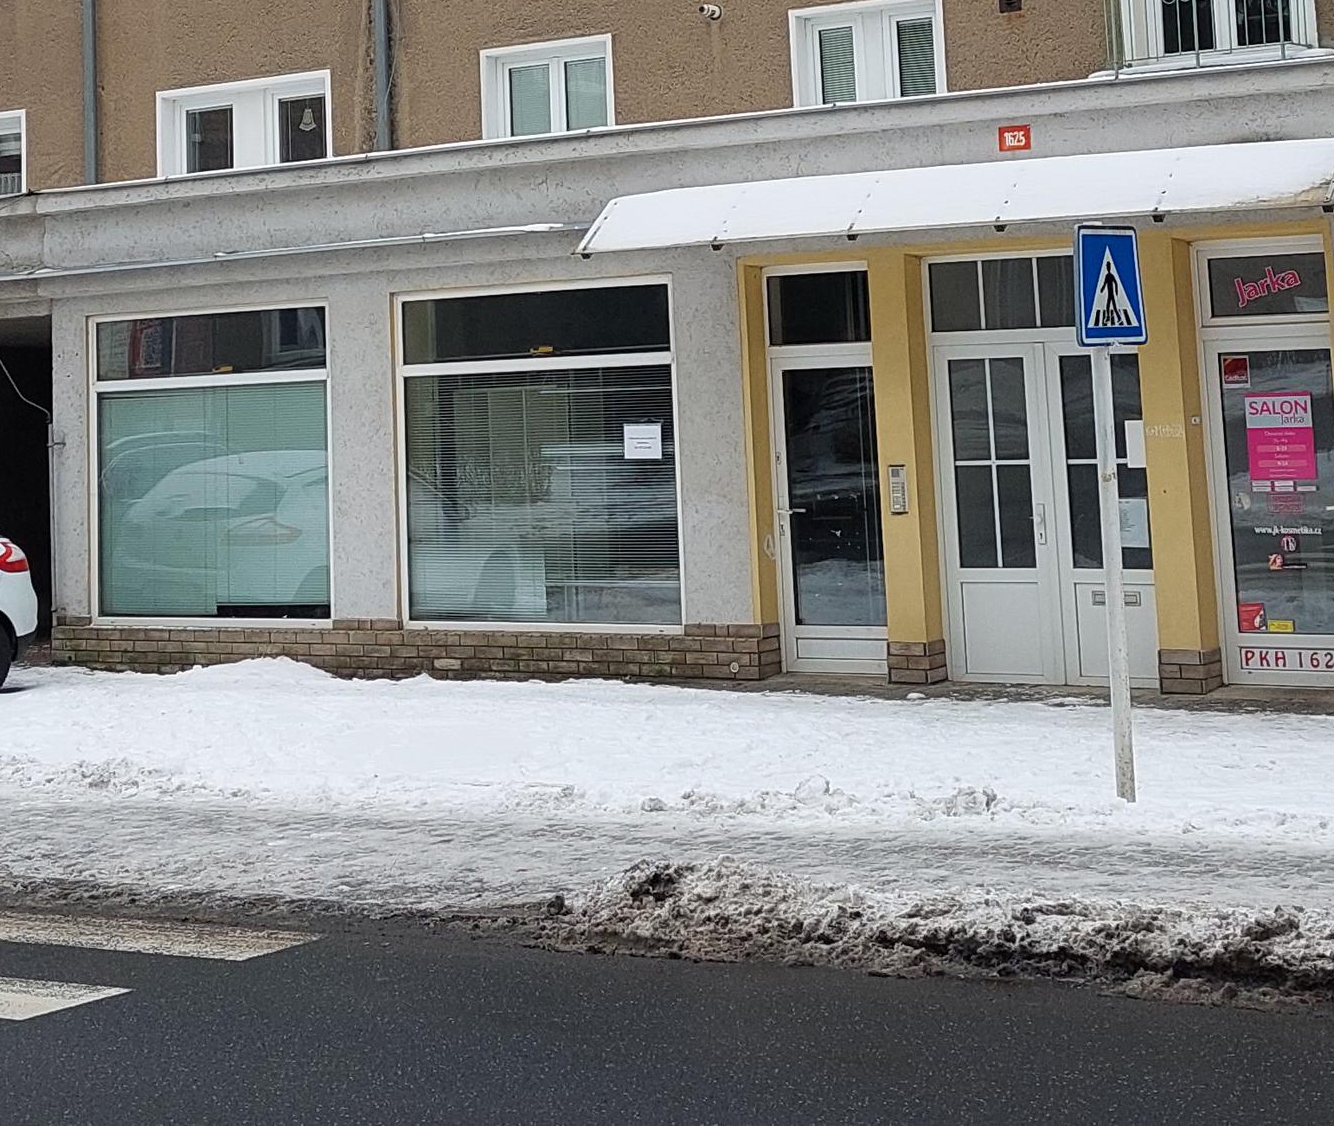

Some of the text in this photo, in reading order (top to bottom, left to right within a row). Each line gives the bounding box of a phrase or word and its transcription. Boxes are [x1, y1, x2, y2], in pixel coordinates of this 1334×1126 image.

[1003, 130, 1026, 147] 1625
[1234, 265, 1302, 308] Jarka
[1248, 399, 1308, 415] SALON
